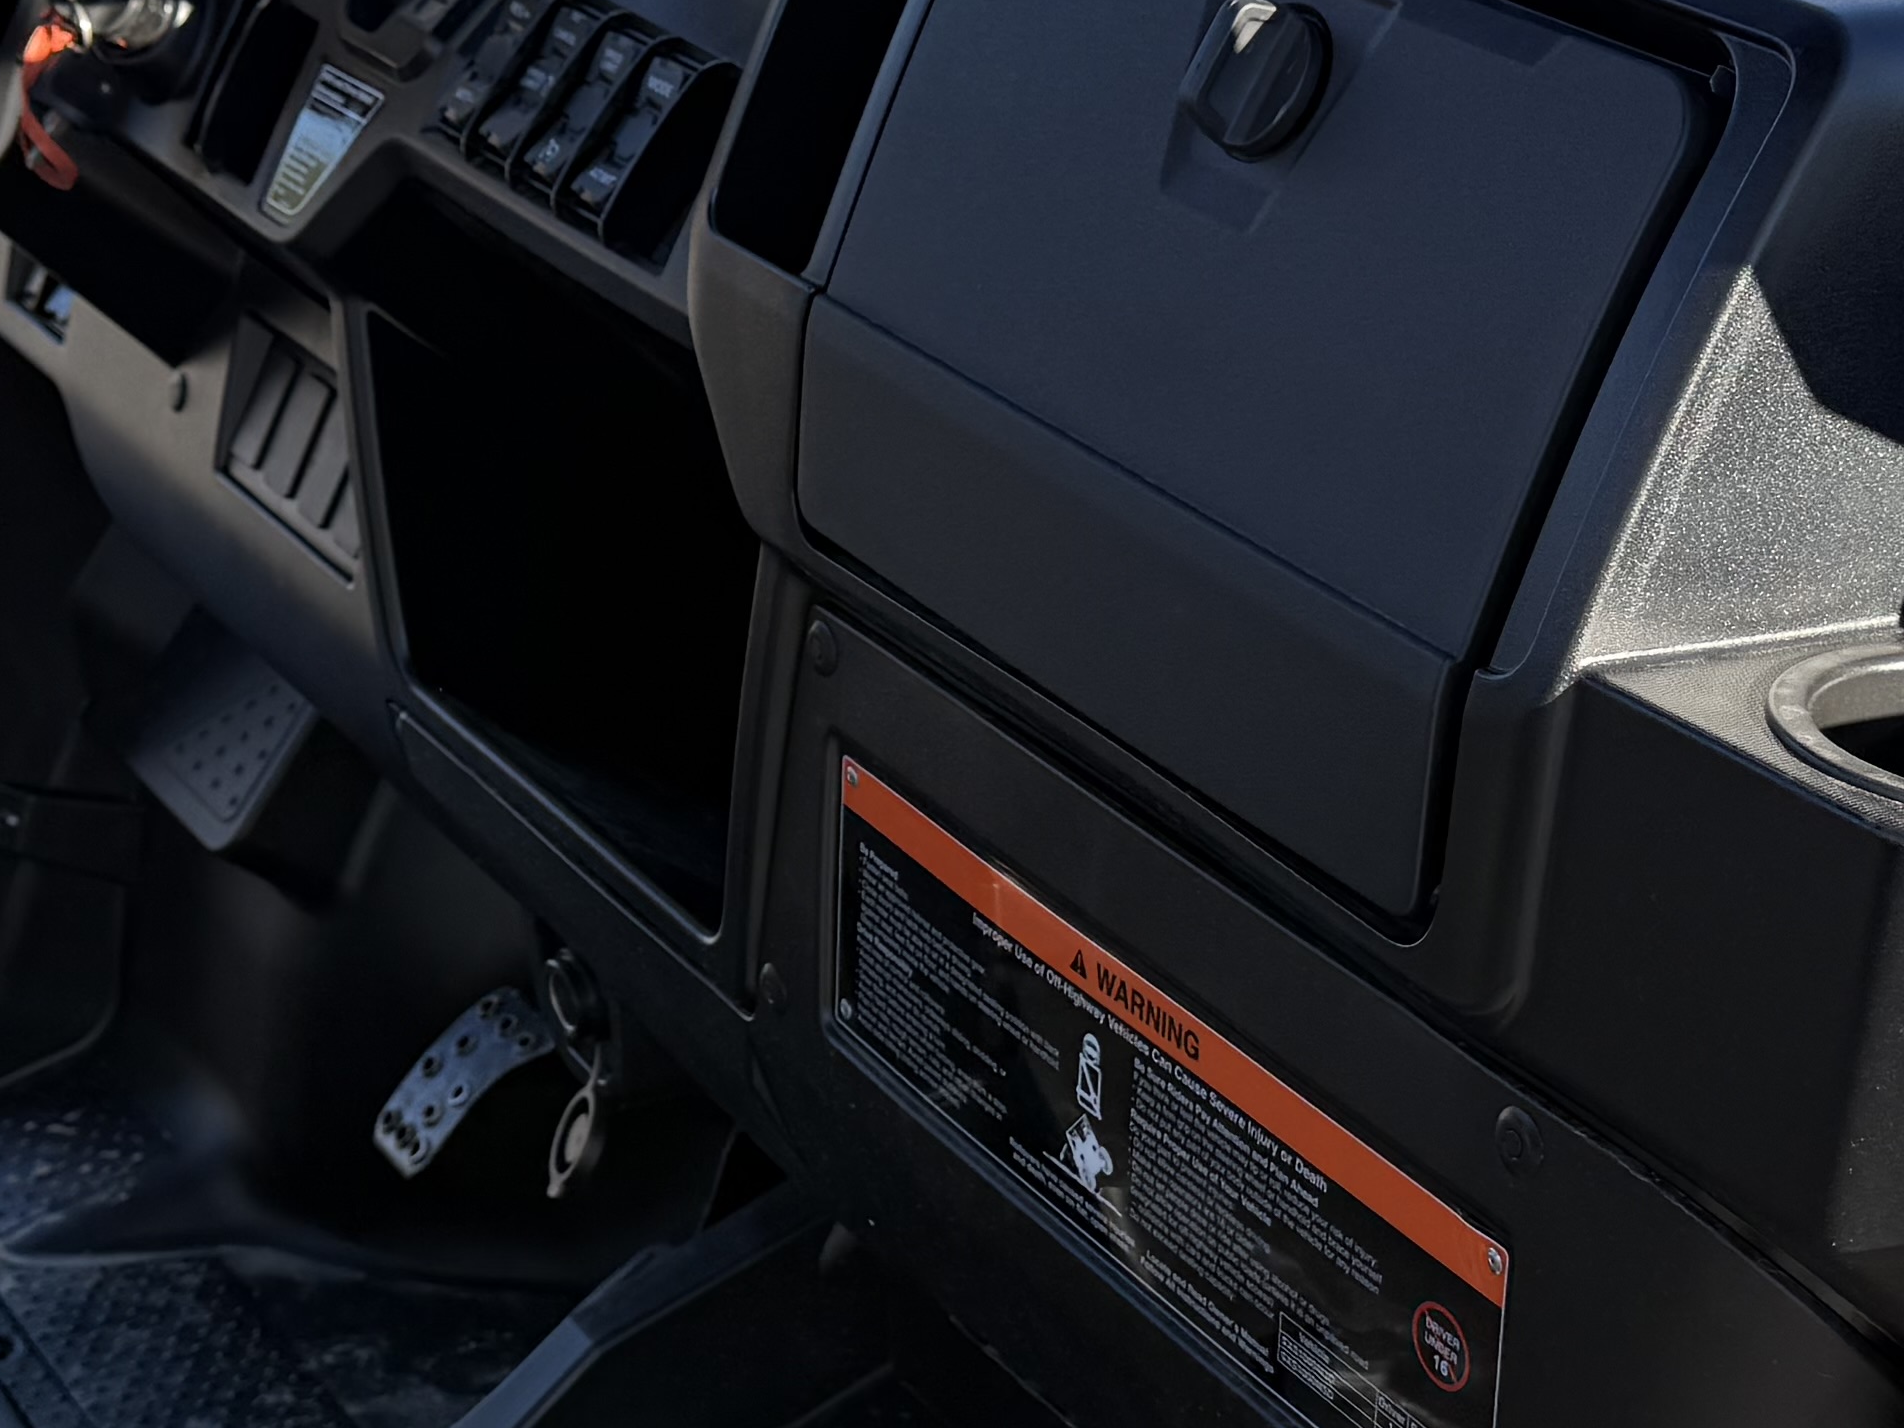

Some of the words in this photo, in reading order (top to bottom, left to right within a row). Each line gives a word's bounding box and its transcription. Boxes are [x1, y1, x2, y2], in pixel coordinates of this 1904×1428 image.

[1096, 963, 1200, 1061] WARNING
[972, 912, 1013, 952] Improper
[1014, 944, 1033, 968] Use
[1033, 962, 1045, 977] of
[1046, 969, 1105, 1024] Off-Highway
[1107, 1014, 1150, 1056] Vehicles
[1151, 1047, 1173, 1074] Can
[1173, 1065, 1207, 1100] Cause
[1209, 1091, 1246, 1129] Severe
[1247, 1120, 1278, 1163] Injury
[1280, 1149, 1293, 1165] or
[1294, 1157, 1327, 1193] Death
[1133, 1056, 1146, 1074] Be
[1146, 1066, 1166, 1090] Sure
[1166, 1081, 1194, 1111] Riders
[1194, 1103, 1211, 1125] Pay
[1211, 1118, 1251, 1155] Attention
[1251, 1149, 1269, 1169] and
[1269, 1161, 1289, 1185] Plan
[1289, 1178, 1319, 1208] Ahead
[1129, 1107, 1162, 1140] Require
[1162, 1132, 1191, 1162] Proper
[1191, 1155, 1209, 1177] Use
[1208, 1172, 1219, 1185] of
[1219, 1176, 1239, 1200] Your
[1240, 1193, 1272, 1227] Vehicle
[1310, 1211, 1329, 1228] your
[1311, 1224, 1327, 1242] and
[1171, 1272, 1187, 1289] and
[1424, 1331, 1458, 1365] UNDER
[1425, 1315, 1460, 1350] DRIVER
[1433, 1354, 1449, 1377] 16
[1377, 1395, 1405, 1424] Driver
